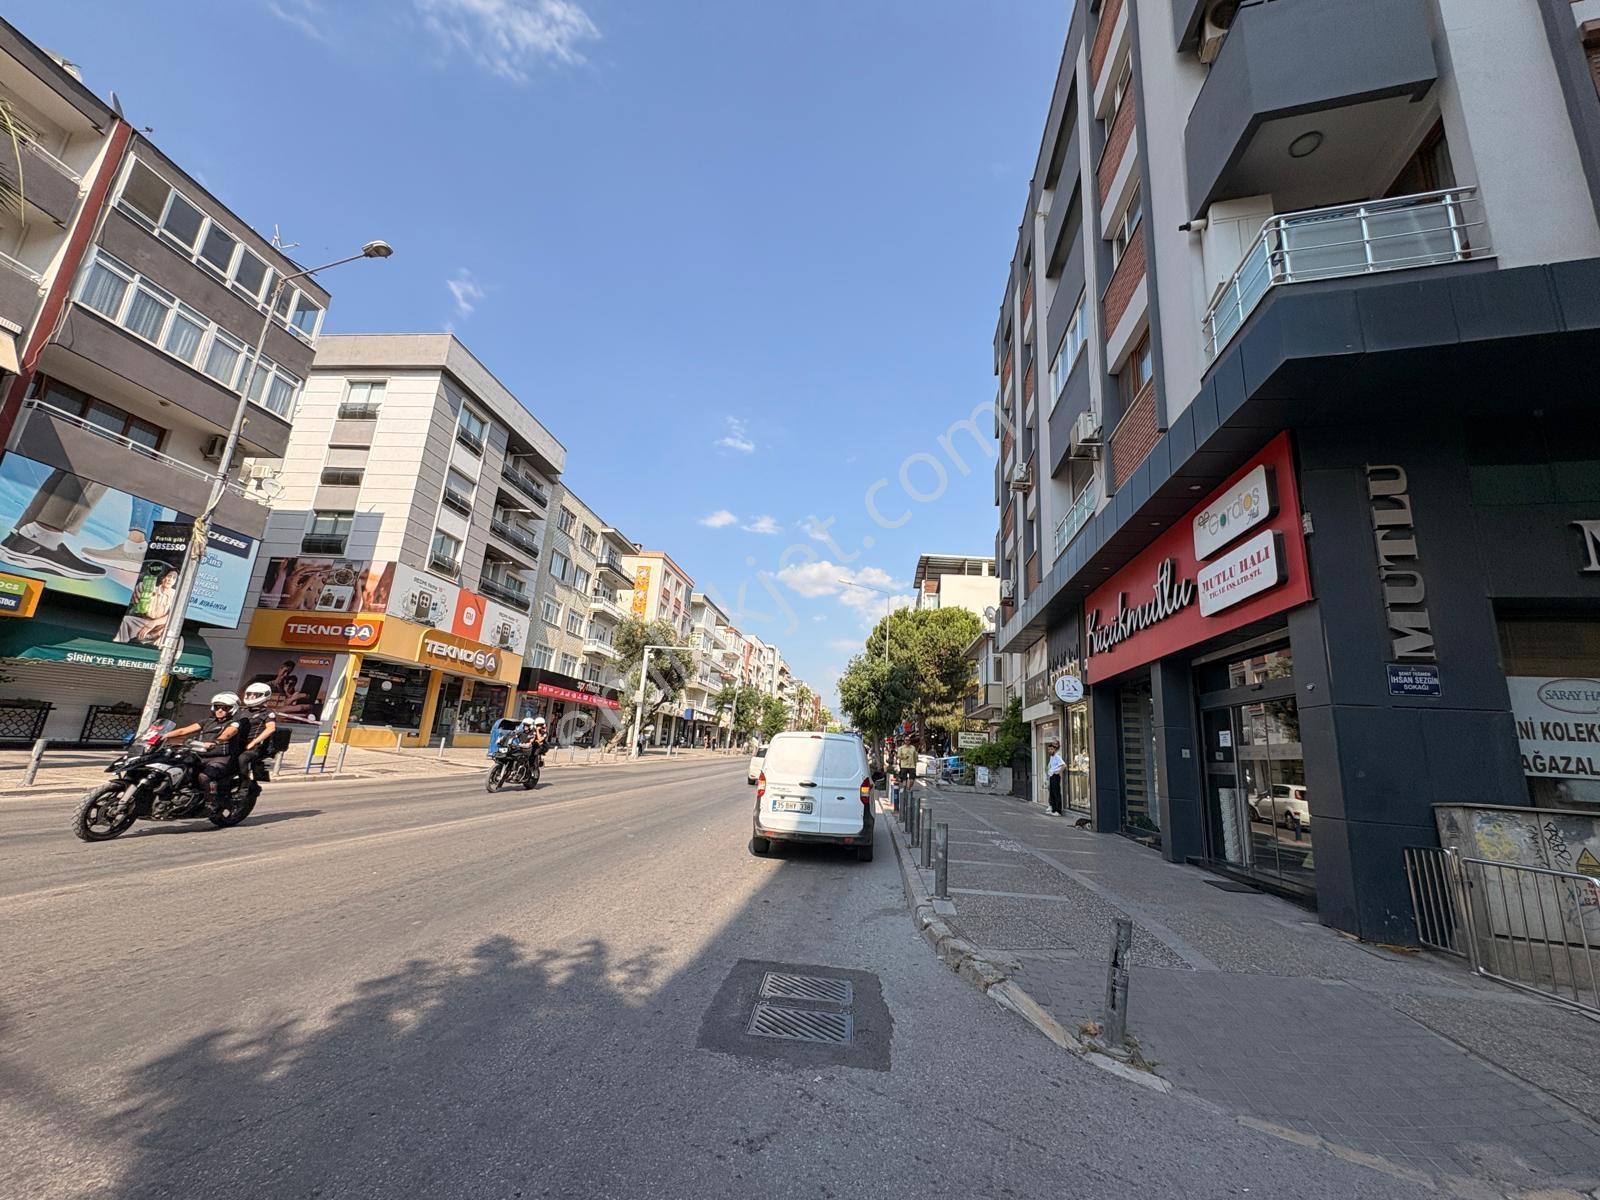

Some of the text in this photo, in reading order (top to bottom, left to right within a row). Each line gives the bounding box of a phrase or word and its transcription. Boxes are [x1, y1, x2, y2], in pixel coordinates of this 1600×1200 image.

[149, 542, 187, 552] OBSESSO
[1202, 545, 1271, 594] MUTLU HALI
[1366, 461, 1437, 660] MUTLU
[1087, 557, 1193, 658] Küçükmutlu
[287, 622, 371, 638] TEKNOSA
[424, 638, 497, 668] TEKNOSA
[172, 665, 194, 675] CAFE
[1544, 689, 1582, 701] SARAY
